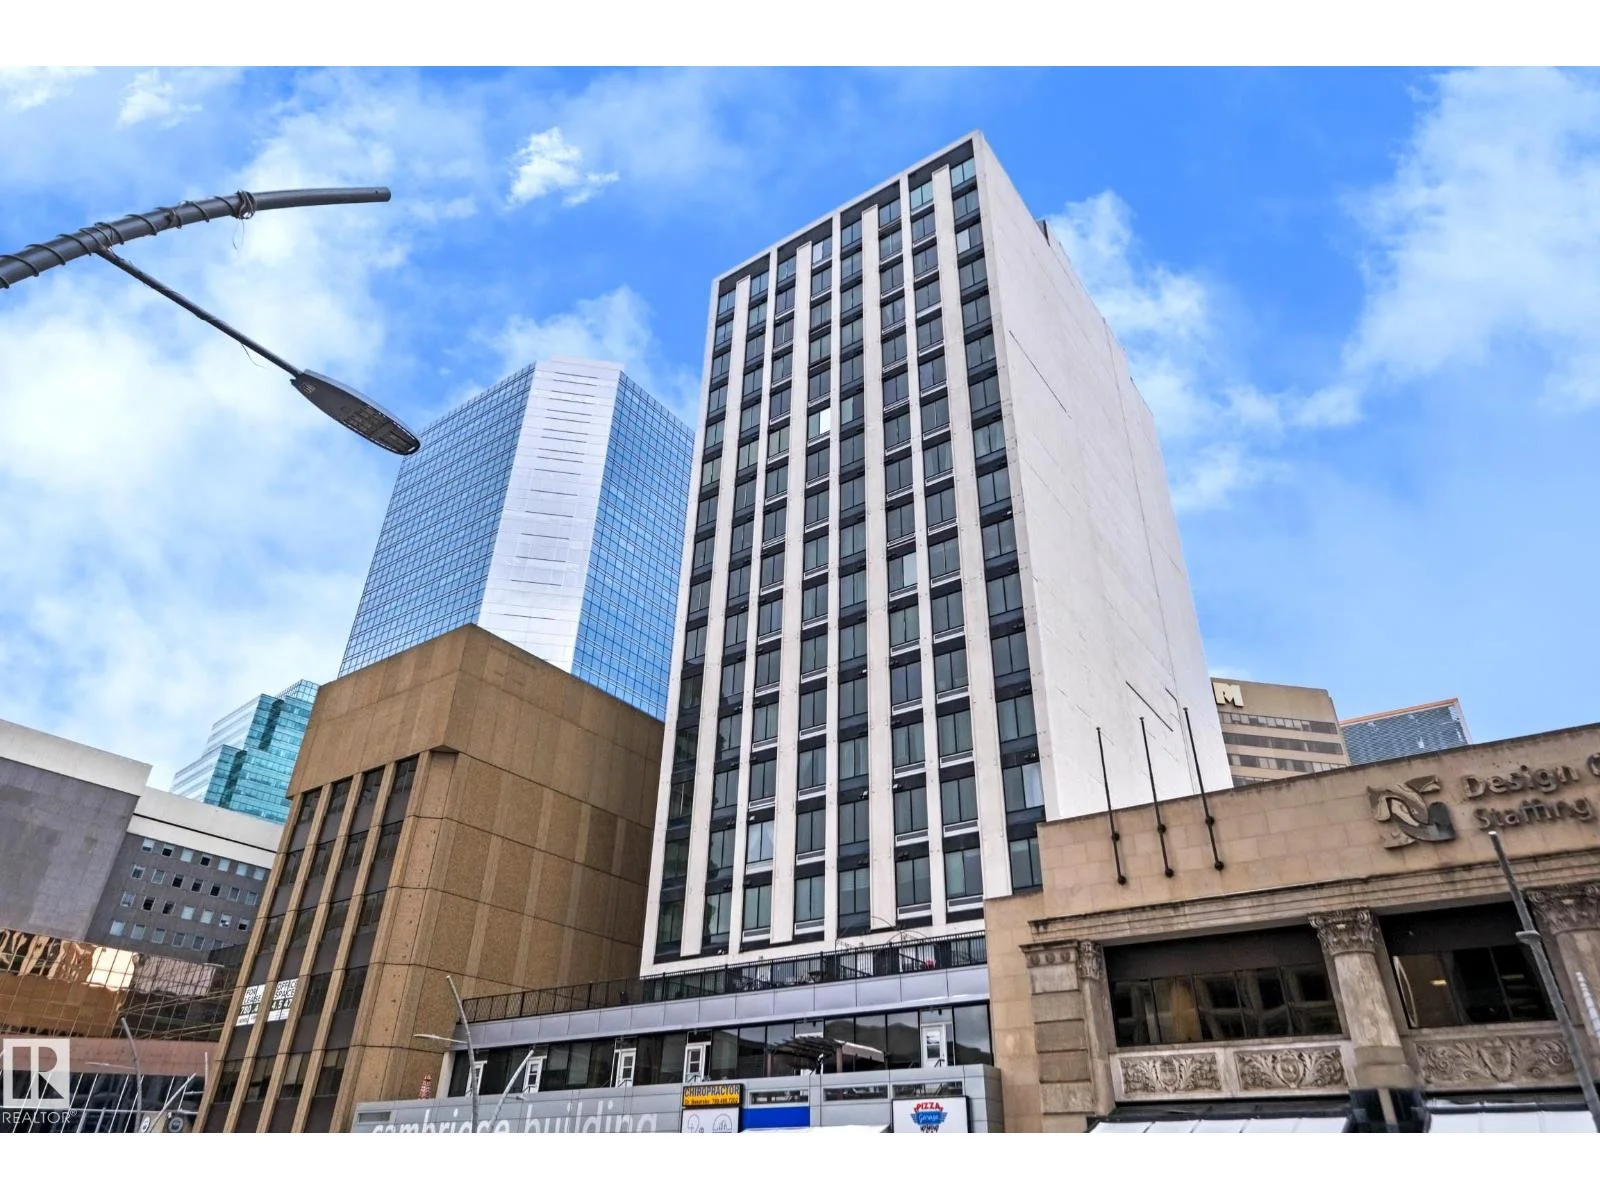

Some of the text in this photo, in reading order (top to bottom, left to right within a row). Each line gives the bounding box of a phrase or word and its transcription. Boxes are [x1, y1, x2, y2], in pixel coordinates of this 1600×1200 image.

[1464, 765, 1579, 797] Design
[1475, 798, 1594, 830] Staffing
[684, 1084, 740, 1097] CHIROPRACTOR
[915, 1101, 941, 1110] PIZZA
